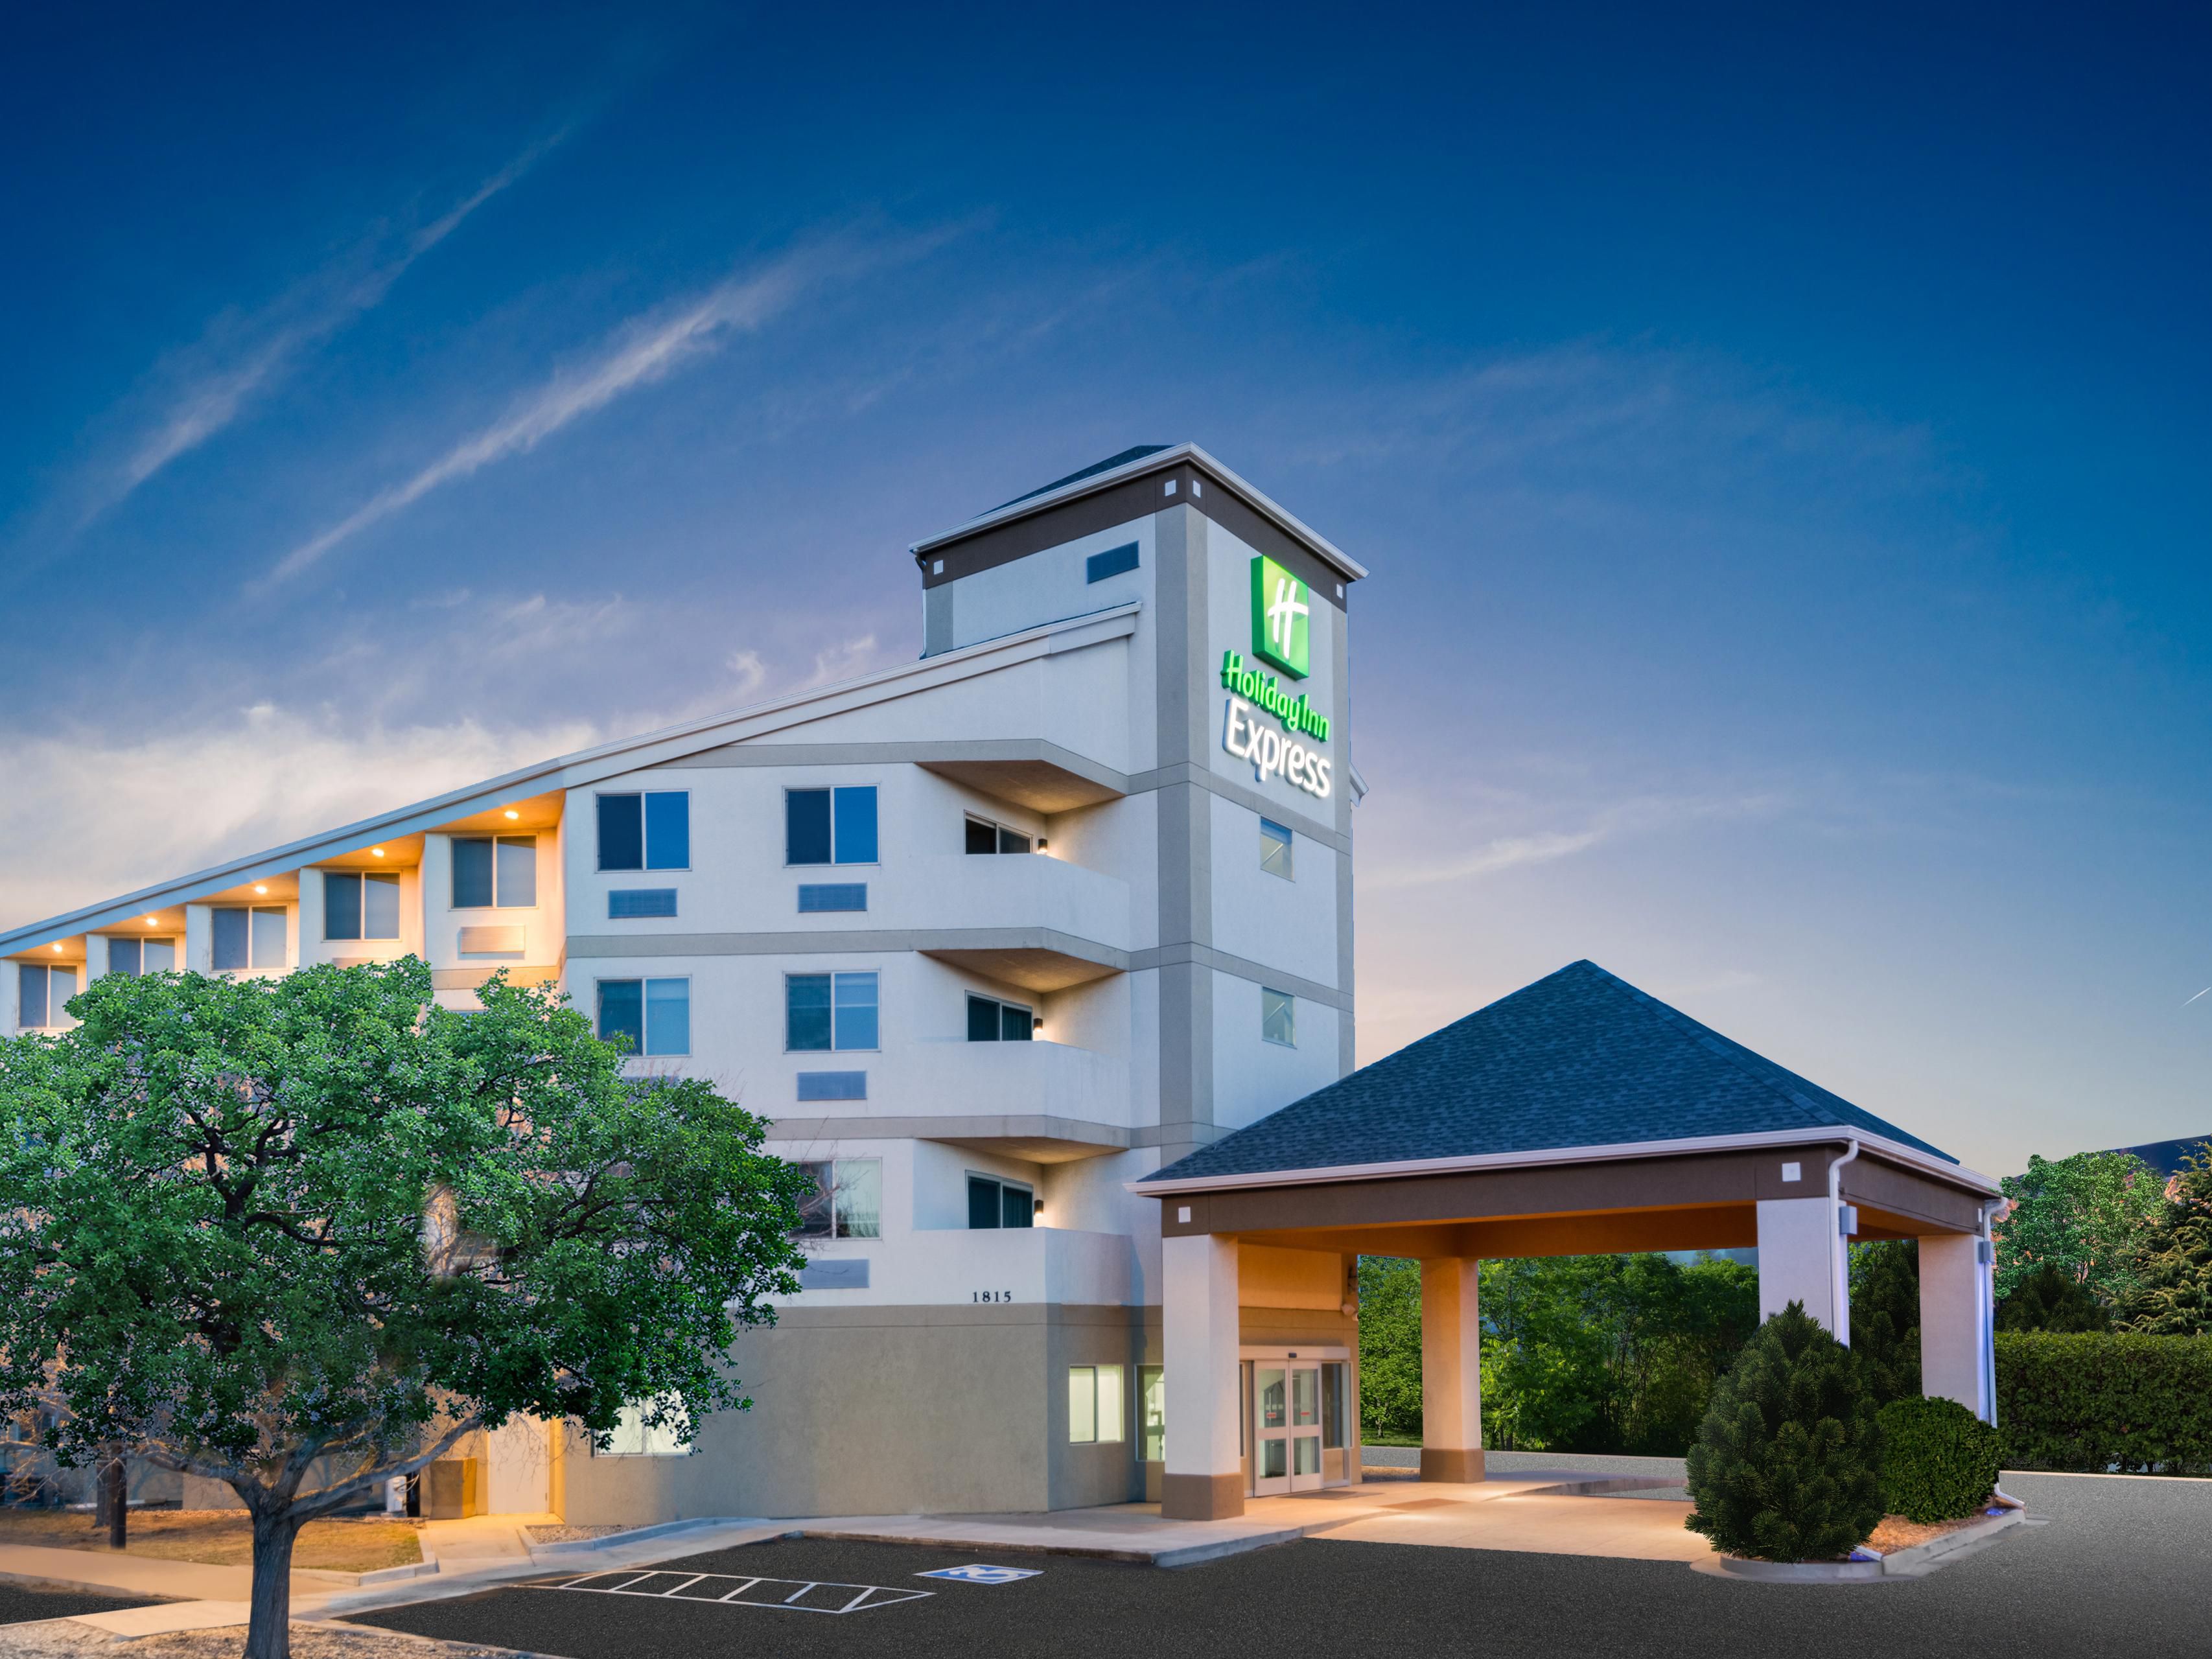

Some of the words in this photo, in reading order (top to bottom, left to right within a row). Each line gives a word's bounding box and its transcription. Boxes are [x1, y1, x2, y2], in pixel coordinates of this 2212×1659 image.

[1221, 649, 1300, 732] Holiday
[1299, 693, 1330, 742] Inn
[1224, 696, 1331, 798] Express
[973, 1291, 1011, 1303] 1815
